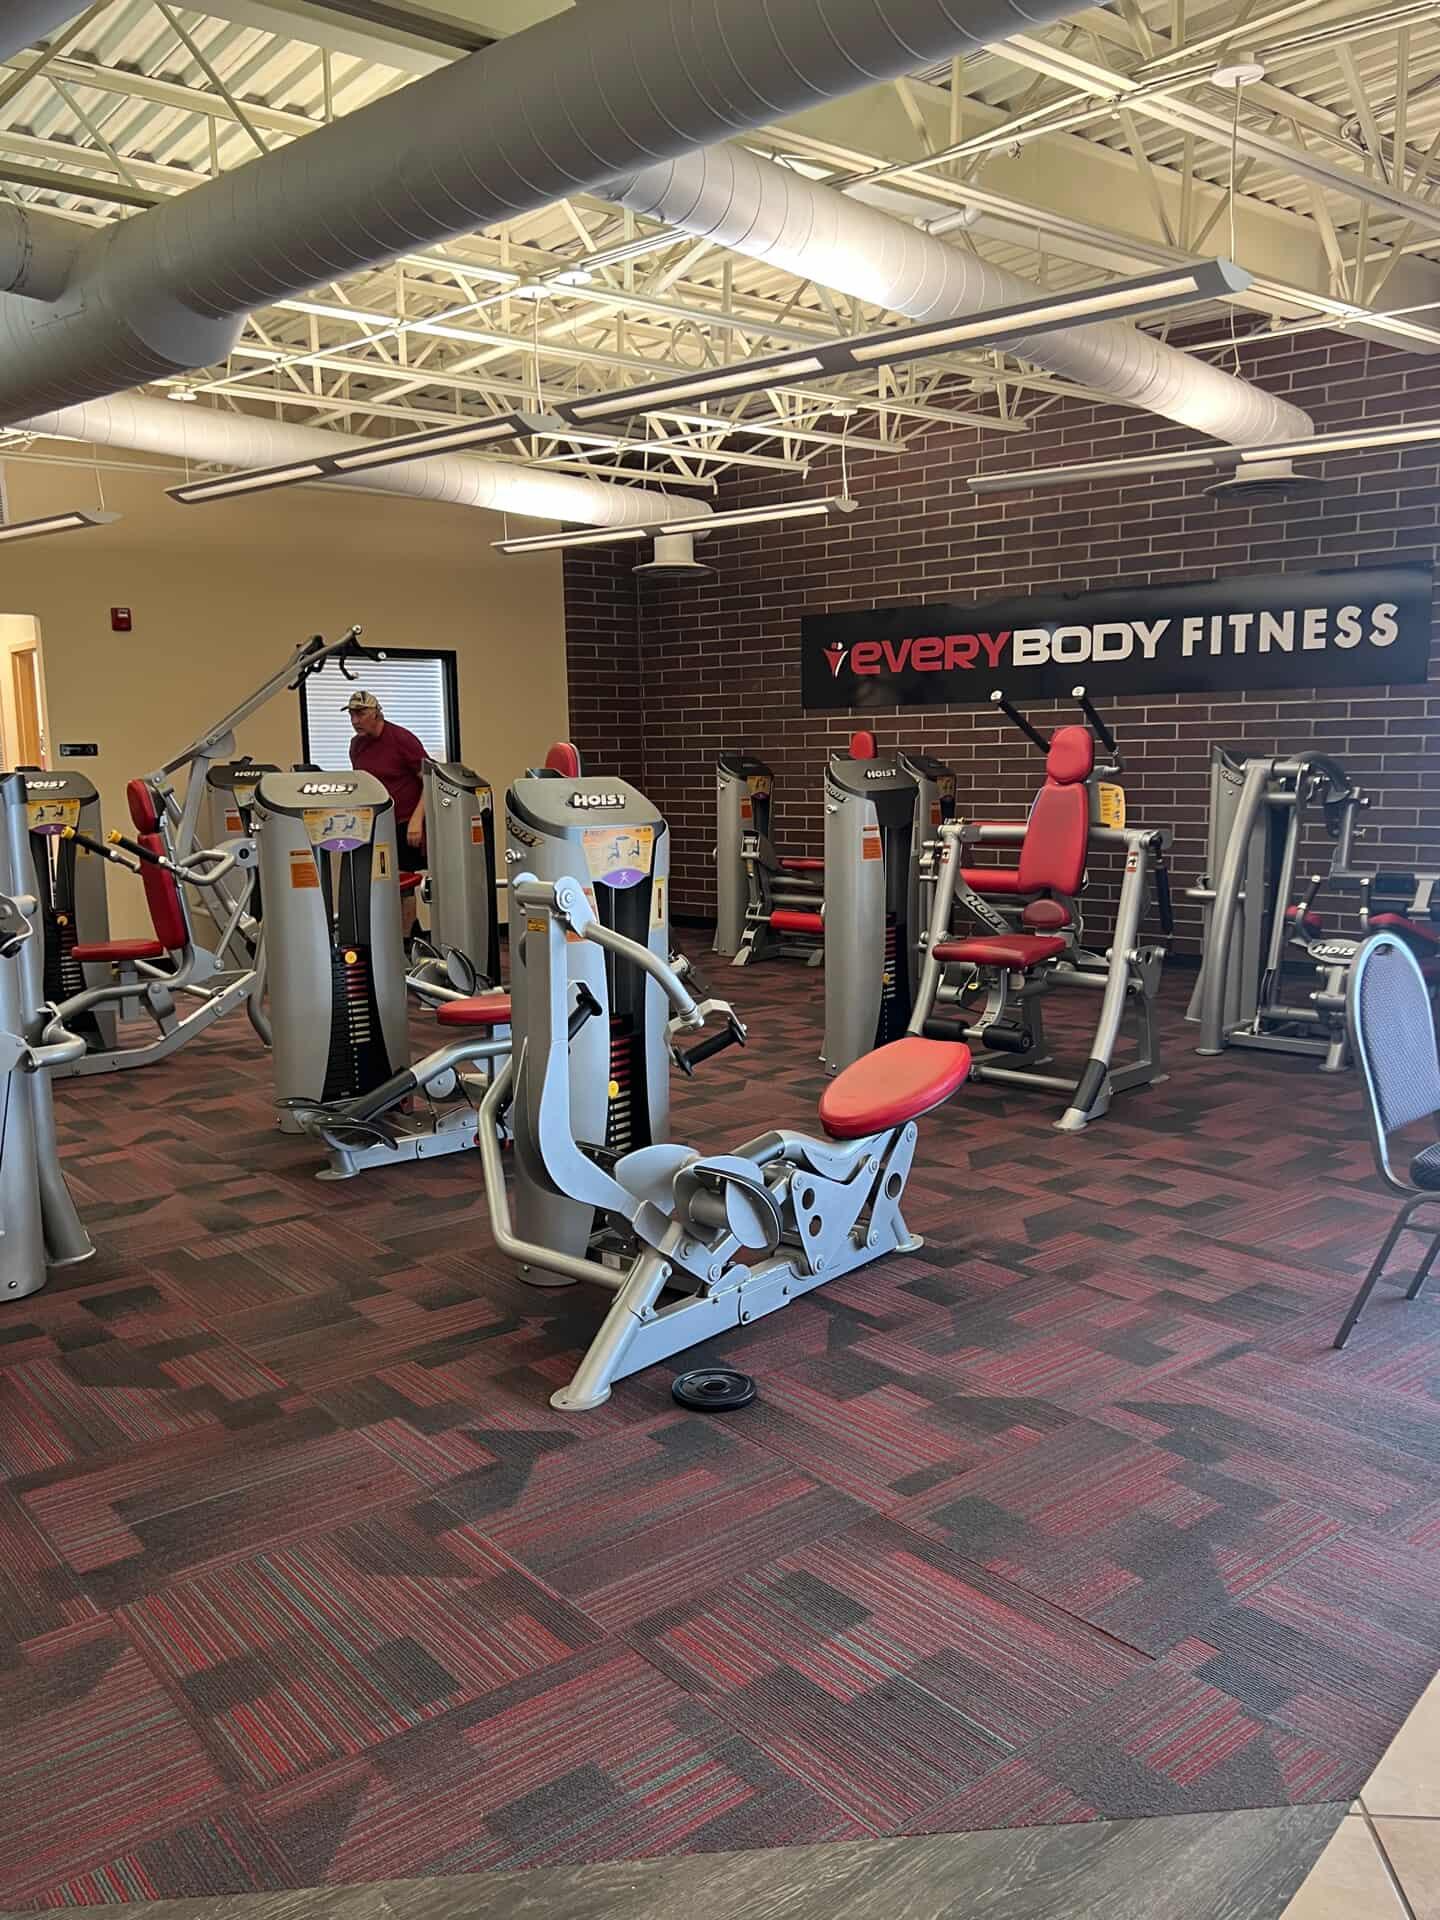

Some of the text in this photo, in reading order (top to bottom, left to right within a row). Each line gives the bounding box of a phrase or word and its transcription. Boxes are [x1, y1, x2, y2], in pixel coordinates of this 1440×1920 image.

[1182, 603, 1399, 657] FITNESS
[867, 769, 896, 778] HOIST
[303, 784, 356, 793] HOIST
[574, 794, 625, 807] HOIST
[966, 896, 1007, 929] HOIST
[1313, 945, 1357, 956] HOIS
